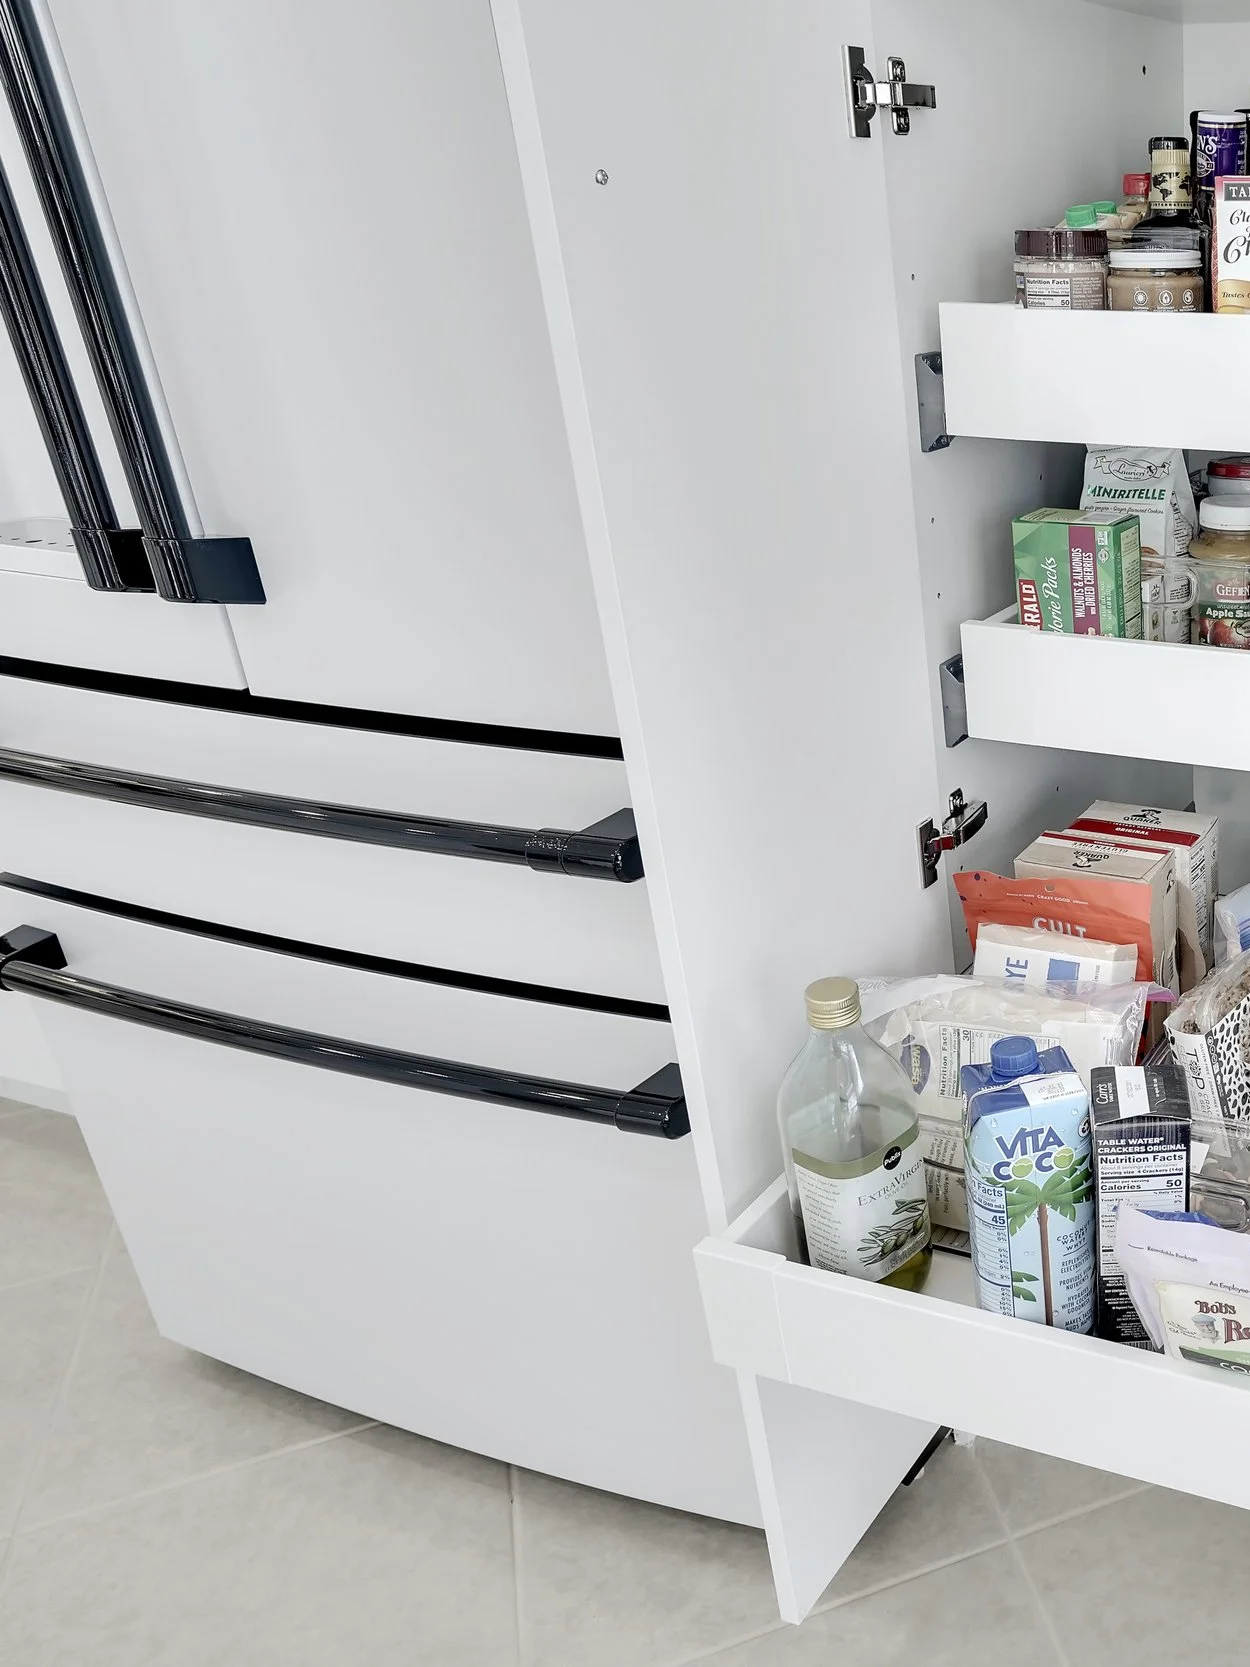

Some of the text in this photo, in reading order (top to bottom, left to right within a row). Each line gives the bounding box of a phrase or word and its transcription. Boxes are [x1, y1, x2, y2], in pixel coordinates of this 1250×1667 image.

[1072, 548, 1083, 580] ALMONDS
[1083, 553, 1094, 584] CHERRIES
[1041, 556, 1060, 598] Packs
[1074, 589, 1086, 618] WALNUTS
[1085, 586, 1095, 606] DRIED
[1206, 608, 1234, 618] Apple
[1123, 817, 1161, 825] QUAKER
[1115, 827, 1149, 835] ORIGINAL
[1074, 851, 1109, 859] QUAKER
[962, 1029, 971, 1041] 30
[939, 1059, 947, 1097] Nutrition
[994, 1124, 1066, 1160] VITA
[1147, 1144, 1186, 1152] ORIGINAL
[992, 1147, 1075, 1181] COCO
[1100, 1154, 1183, 1164] Nutrition Facts
[977, 1182, 1003, 1198] Facts
[1166, 1179, 1182, 1187] 50
[858, 1182, 896, 1206] EXTRA
[991, 1215, 1006, 1225] 45
[1056, 1220, 1090, 1241] COCONUT
[1176, 1252, 1198, 1262] Package
[1060, 1273, 1082, 1286] PROVIDES
[1194, 1300, 1237, 1315] Bob's
